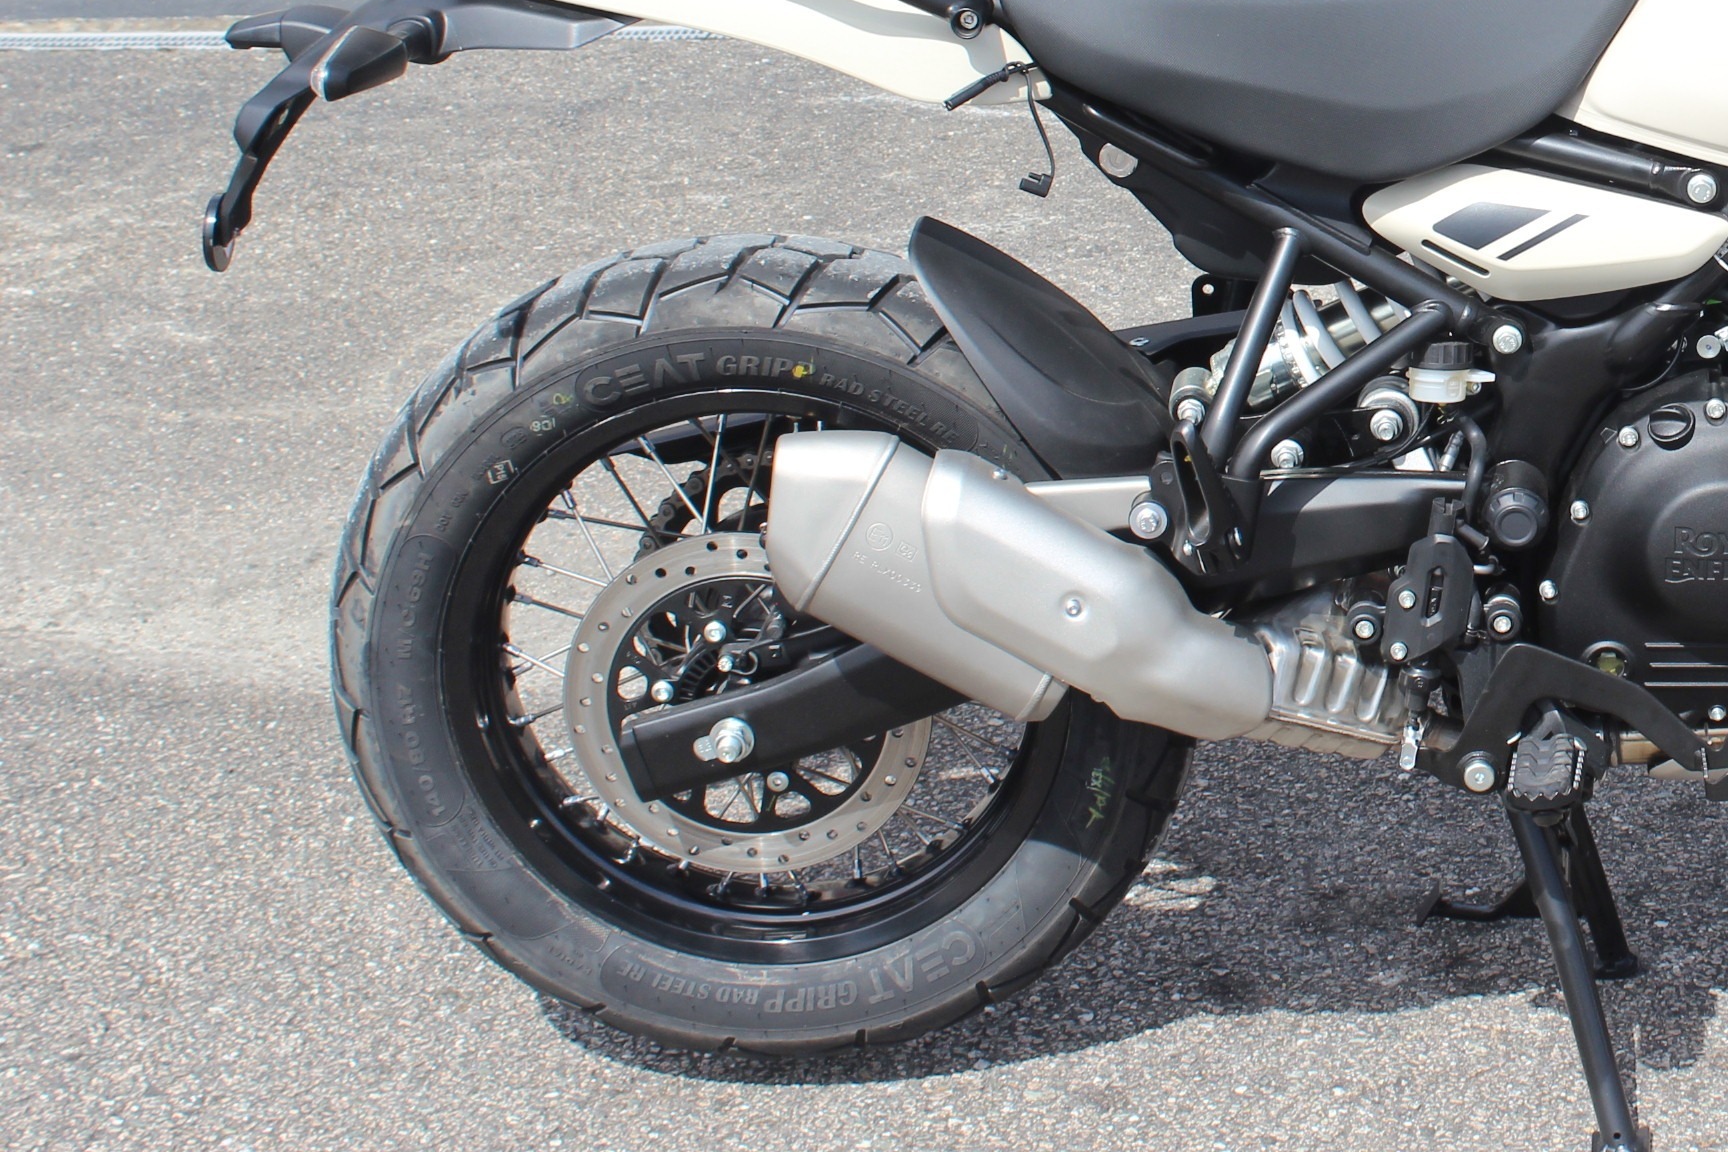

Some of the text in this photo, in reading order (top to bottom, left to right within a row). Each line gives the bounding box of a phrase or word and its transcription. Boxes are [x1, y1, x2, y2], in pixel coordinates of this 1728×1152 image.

[583, 352, 706, 406] CEAT
[818, 373, 864, 397] RAD
[869, 389, 927, 427] STEEL
[616, 934, 976, 1014] CEAT GRIPP RAD STEEL RE
